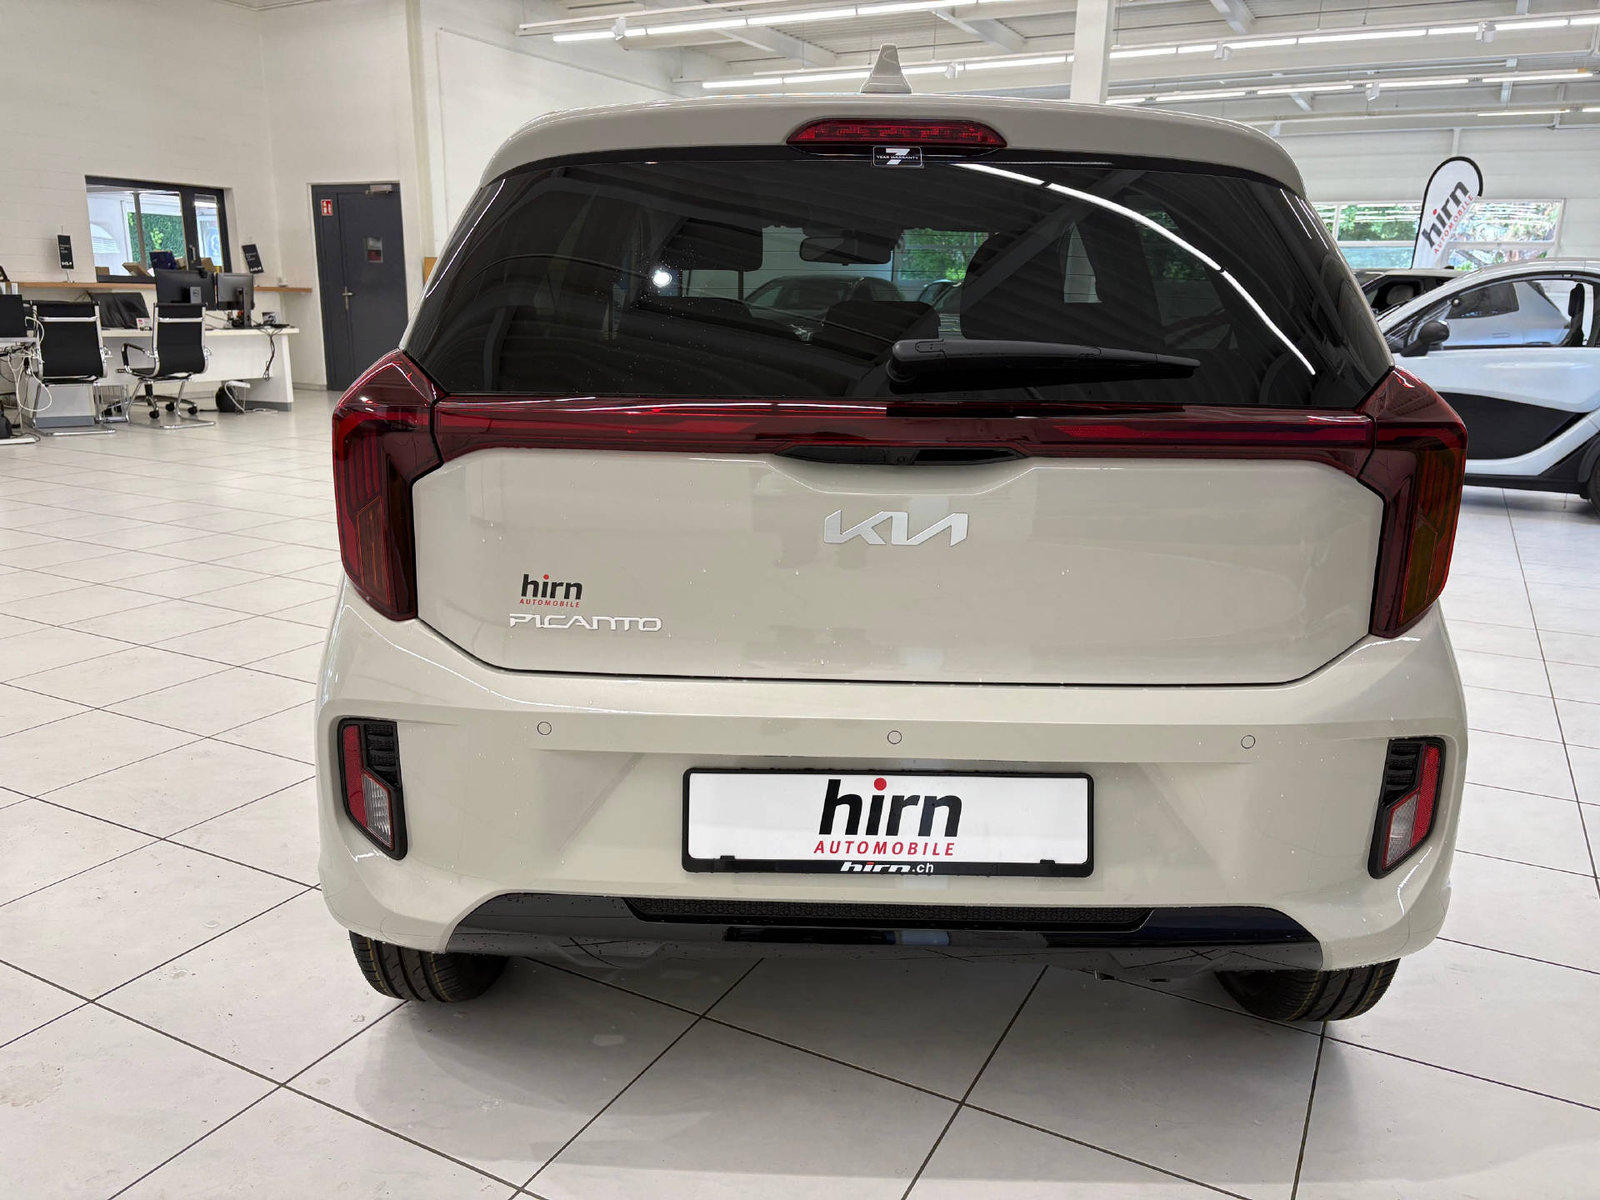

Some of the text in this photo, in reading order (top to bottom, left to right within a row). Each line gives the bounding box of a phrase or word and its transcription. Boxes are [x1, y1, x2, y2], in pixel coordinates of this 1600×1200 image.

[885, 148, 910, 165] 7
[1421, 181, 1470, 248] hirn
[1434, 194, 1474, 255] AUTOMOBILE
[823, 509, 969, 546] KIA
[520, 573, 583, 600] hirn
[519, 599, 580, 608] AUTOMOBILE
[509, 613, 662, 632] PICANTO
[818, 777, 962, 838] hirn
[814, 839, 956, 857] AUTOMOBILE
[840, 860, 934, 875] hirn.ch
